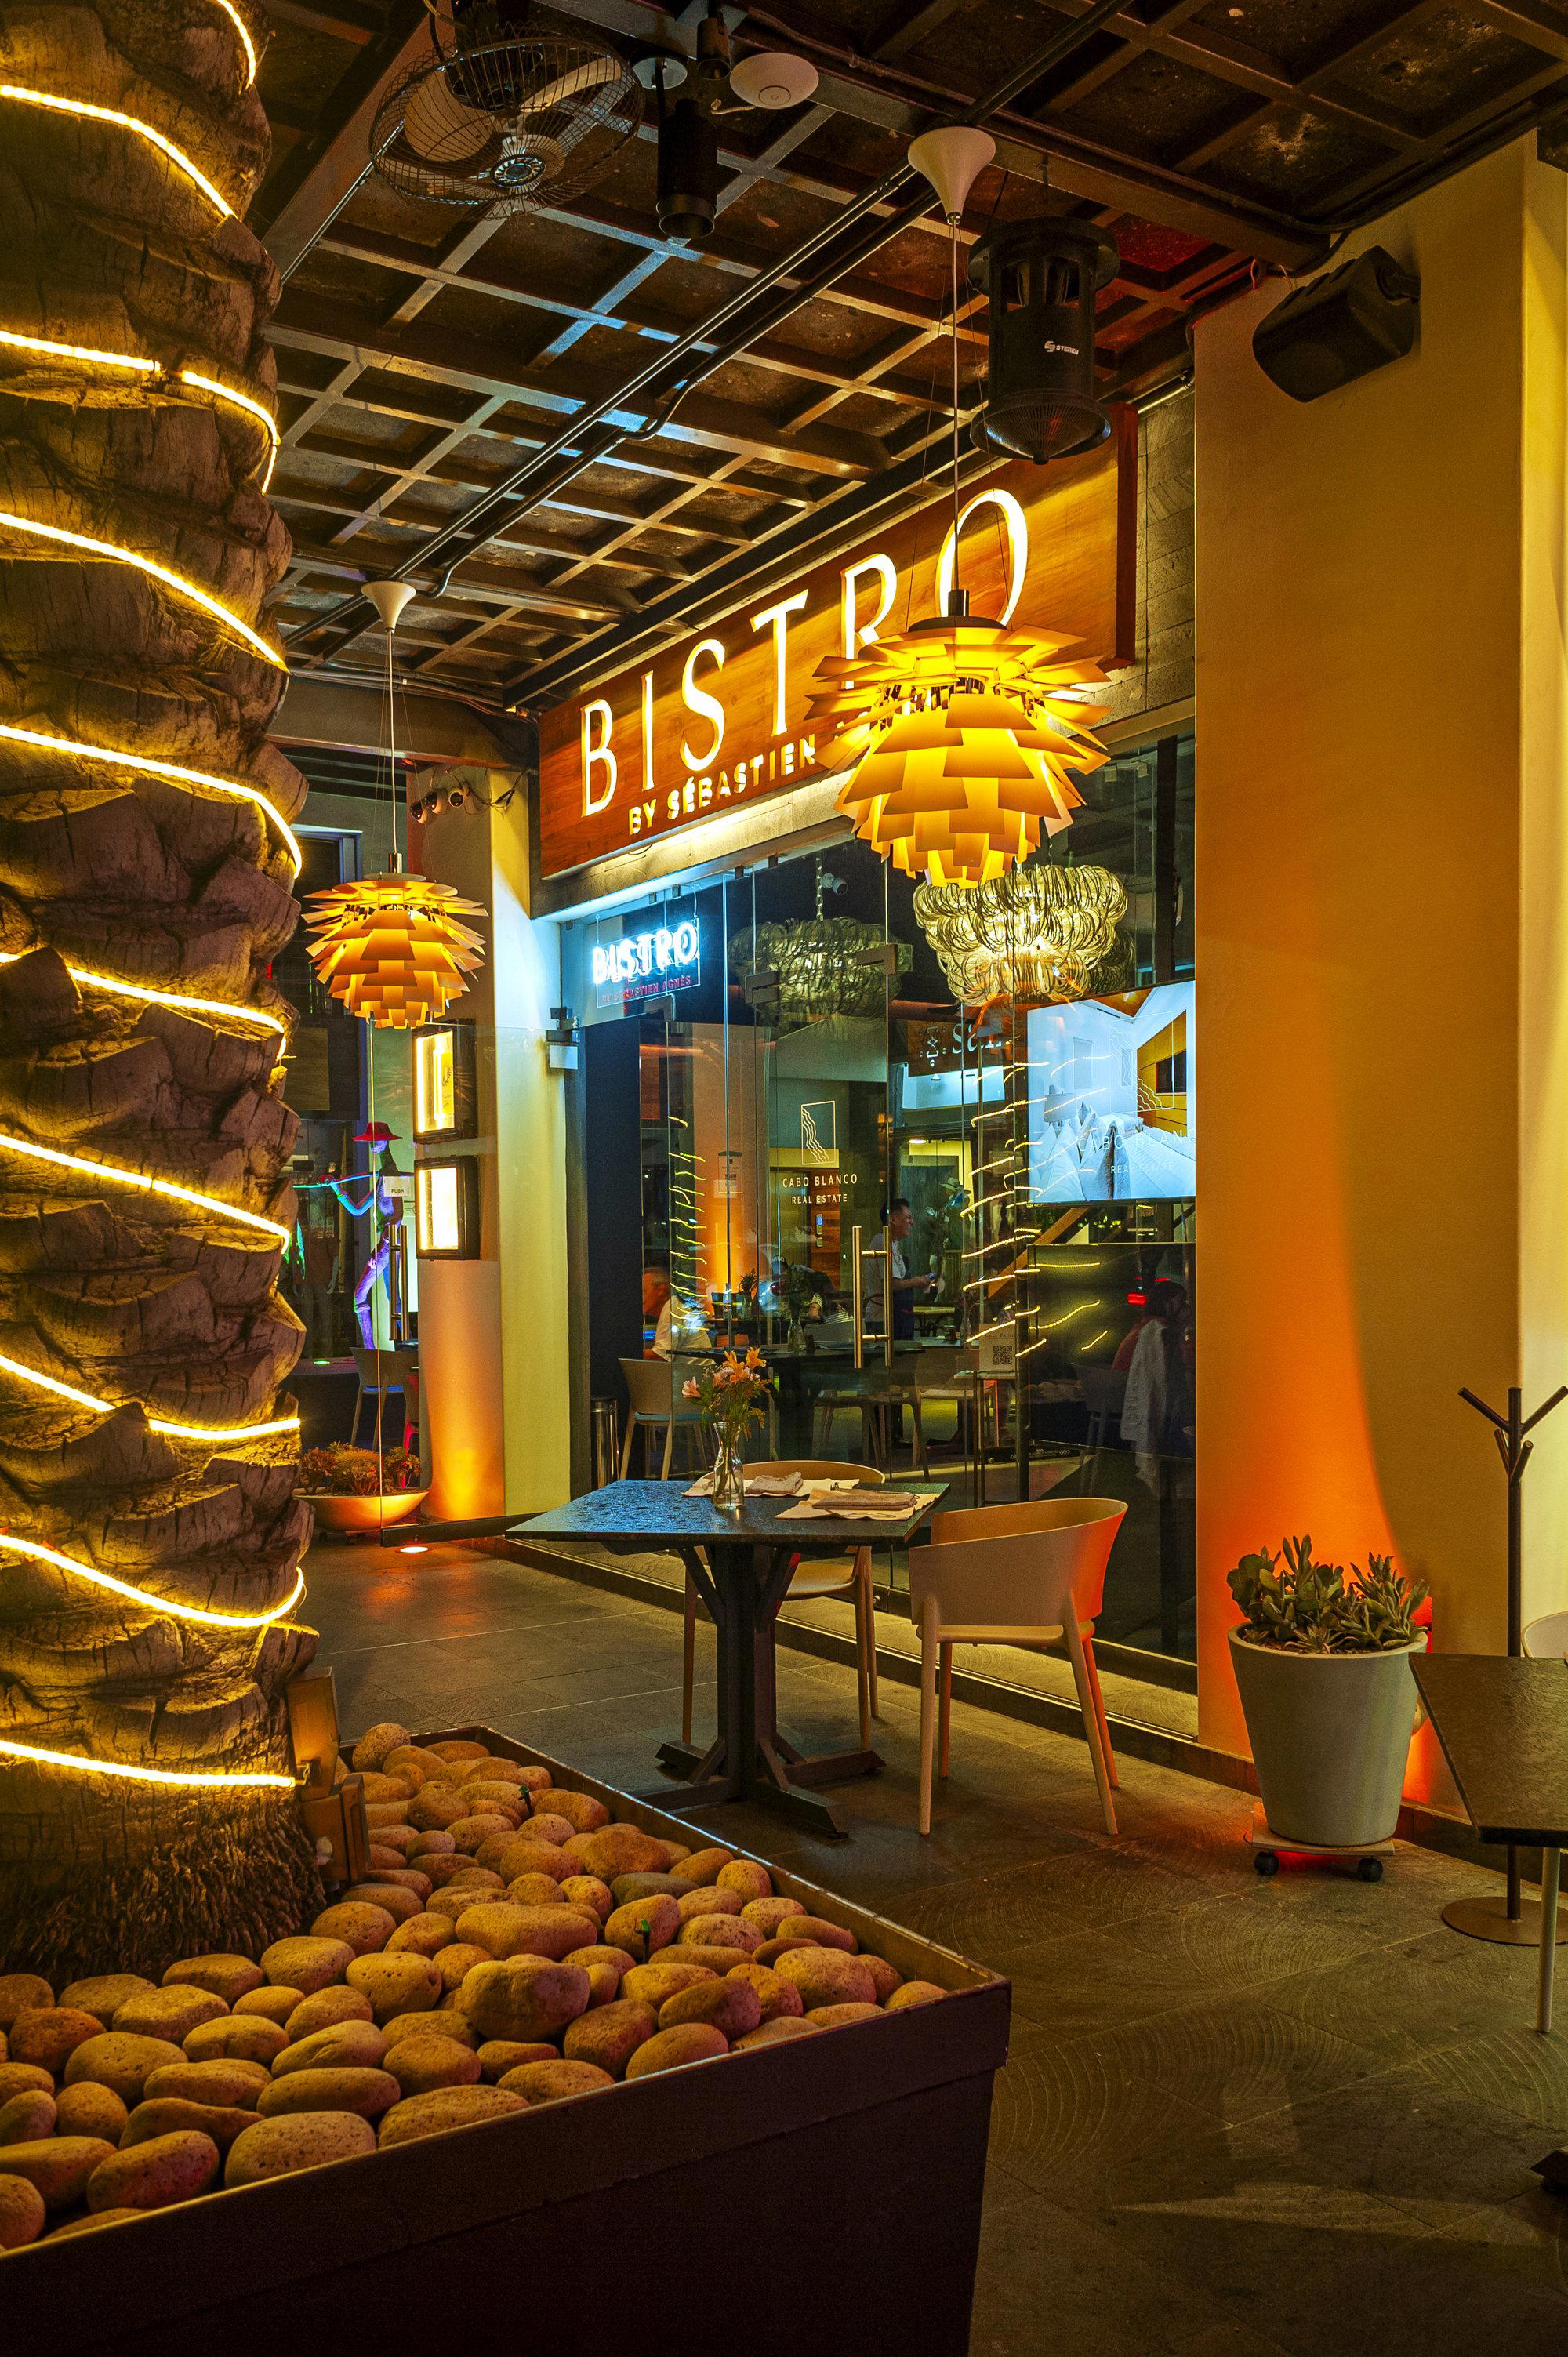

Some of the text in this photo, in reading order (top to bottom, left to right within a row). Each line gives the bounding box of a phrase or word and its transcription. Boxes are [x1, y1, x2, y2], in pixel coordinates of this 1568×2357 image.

[1056, 345, 1080, 355] STEREN
[580, 488, 1028, 818] BISTRO
[629, 733, 816, 836] BY SÉBASTIEN
[592, 921, 699, 985] BISTRO
[662, 975, 691, 992] AGNÈS
[1078, 1129, 1196, 1153] CABO BLANC
[782, 1173, 858, 1188] CABO BLANCO
[791, 1193, 848, 1204] REAL ESTATE
